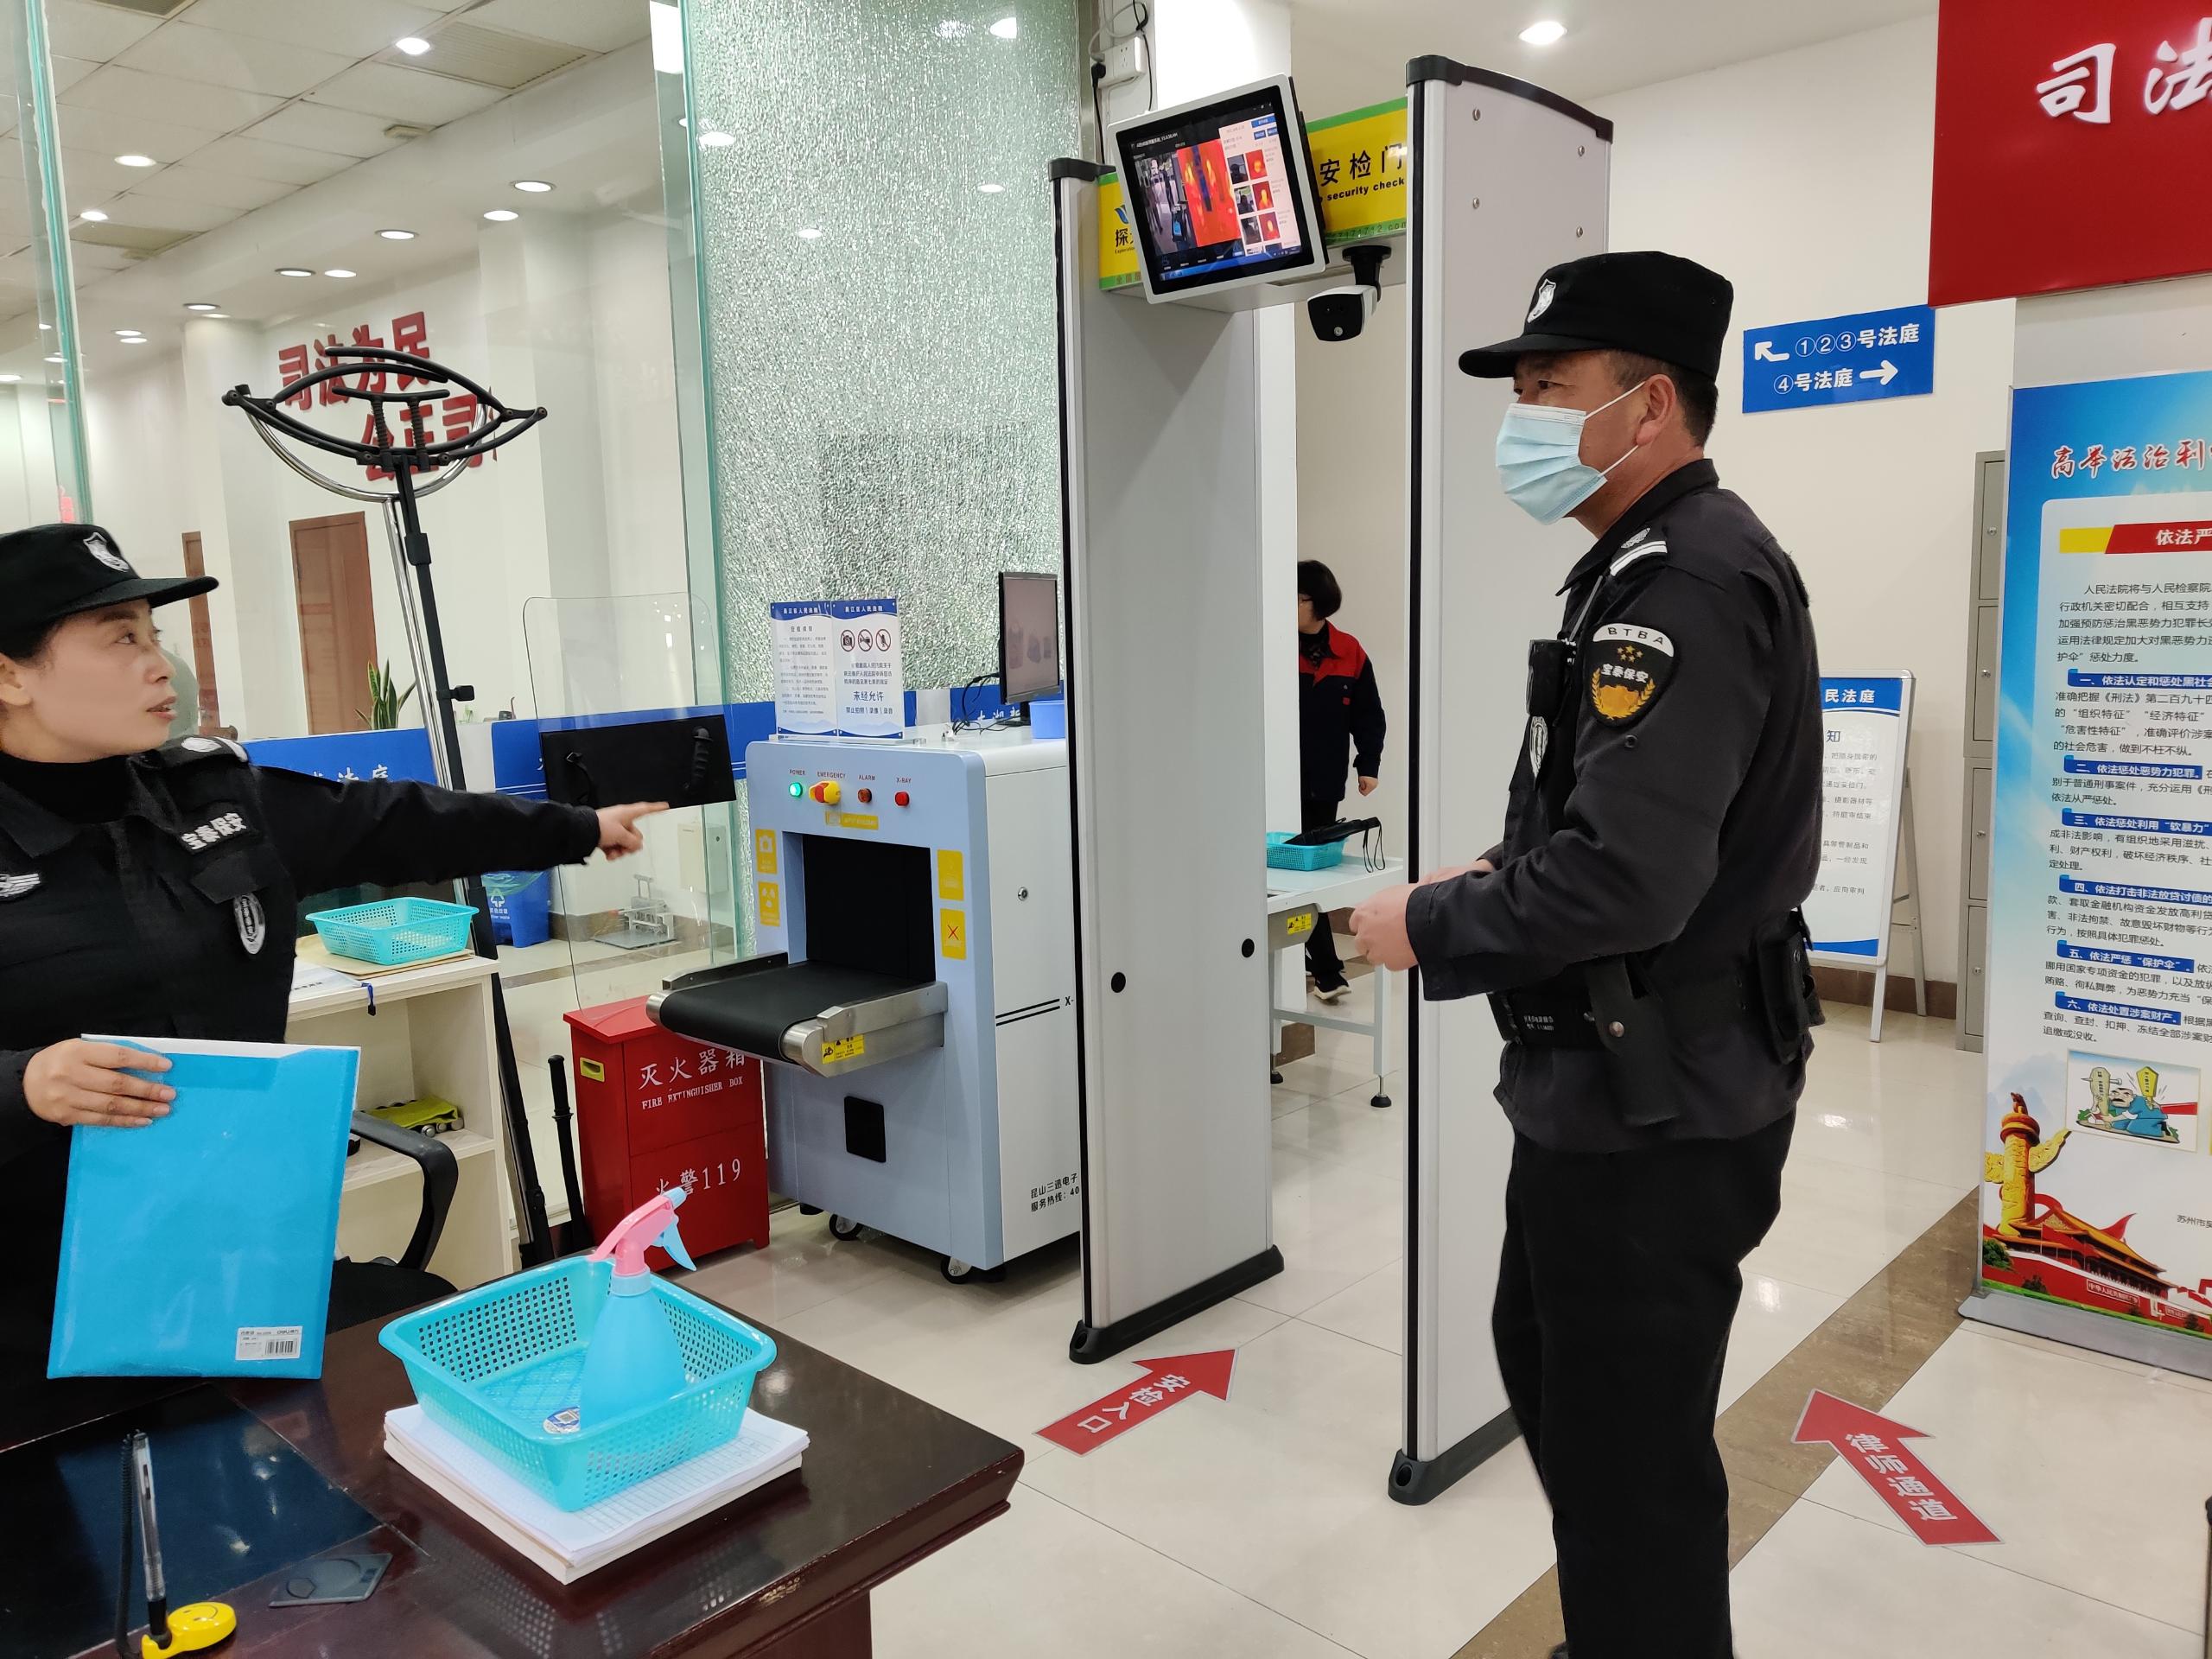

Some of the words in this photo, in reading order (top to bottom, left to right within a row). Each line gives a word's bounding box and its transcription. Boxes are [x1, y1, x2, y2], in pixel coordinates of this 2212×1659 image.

[1319, 143, 1402, 187] 安检门
[1327, 186, 1370, 201] security
[1373, 177, 1405, 191] check
[1115, 228, 1135, 248] 探
[1795, 323, 1920, 358] ①②③号法庭
[1773, 367, 1853, 394] ④号法庭
[2050, 439, 2212, 479] 高举法治利
[2083, 582, 2212, 595] 人民法院将与人民检察院
[1607, 626, 1664, 645] BTBA
[853, 690, 885, 702] 未经允许
[1825, 688, 1876, 703] 民法庭
[1826, 730, 1840, 742] 知
[2049, 860, 2083, 871] 定处理。
[639, 1048, 746, 1090] 灭火器箱
[642, 1096, 663, 1110] FIRE
[729, 1076, 744, 1088] BOX
[1077, 1374, 1191, 1433] 安检入口
